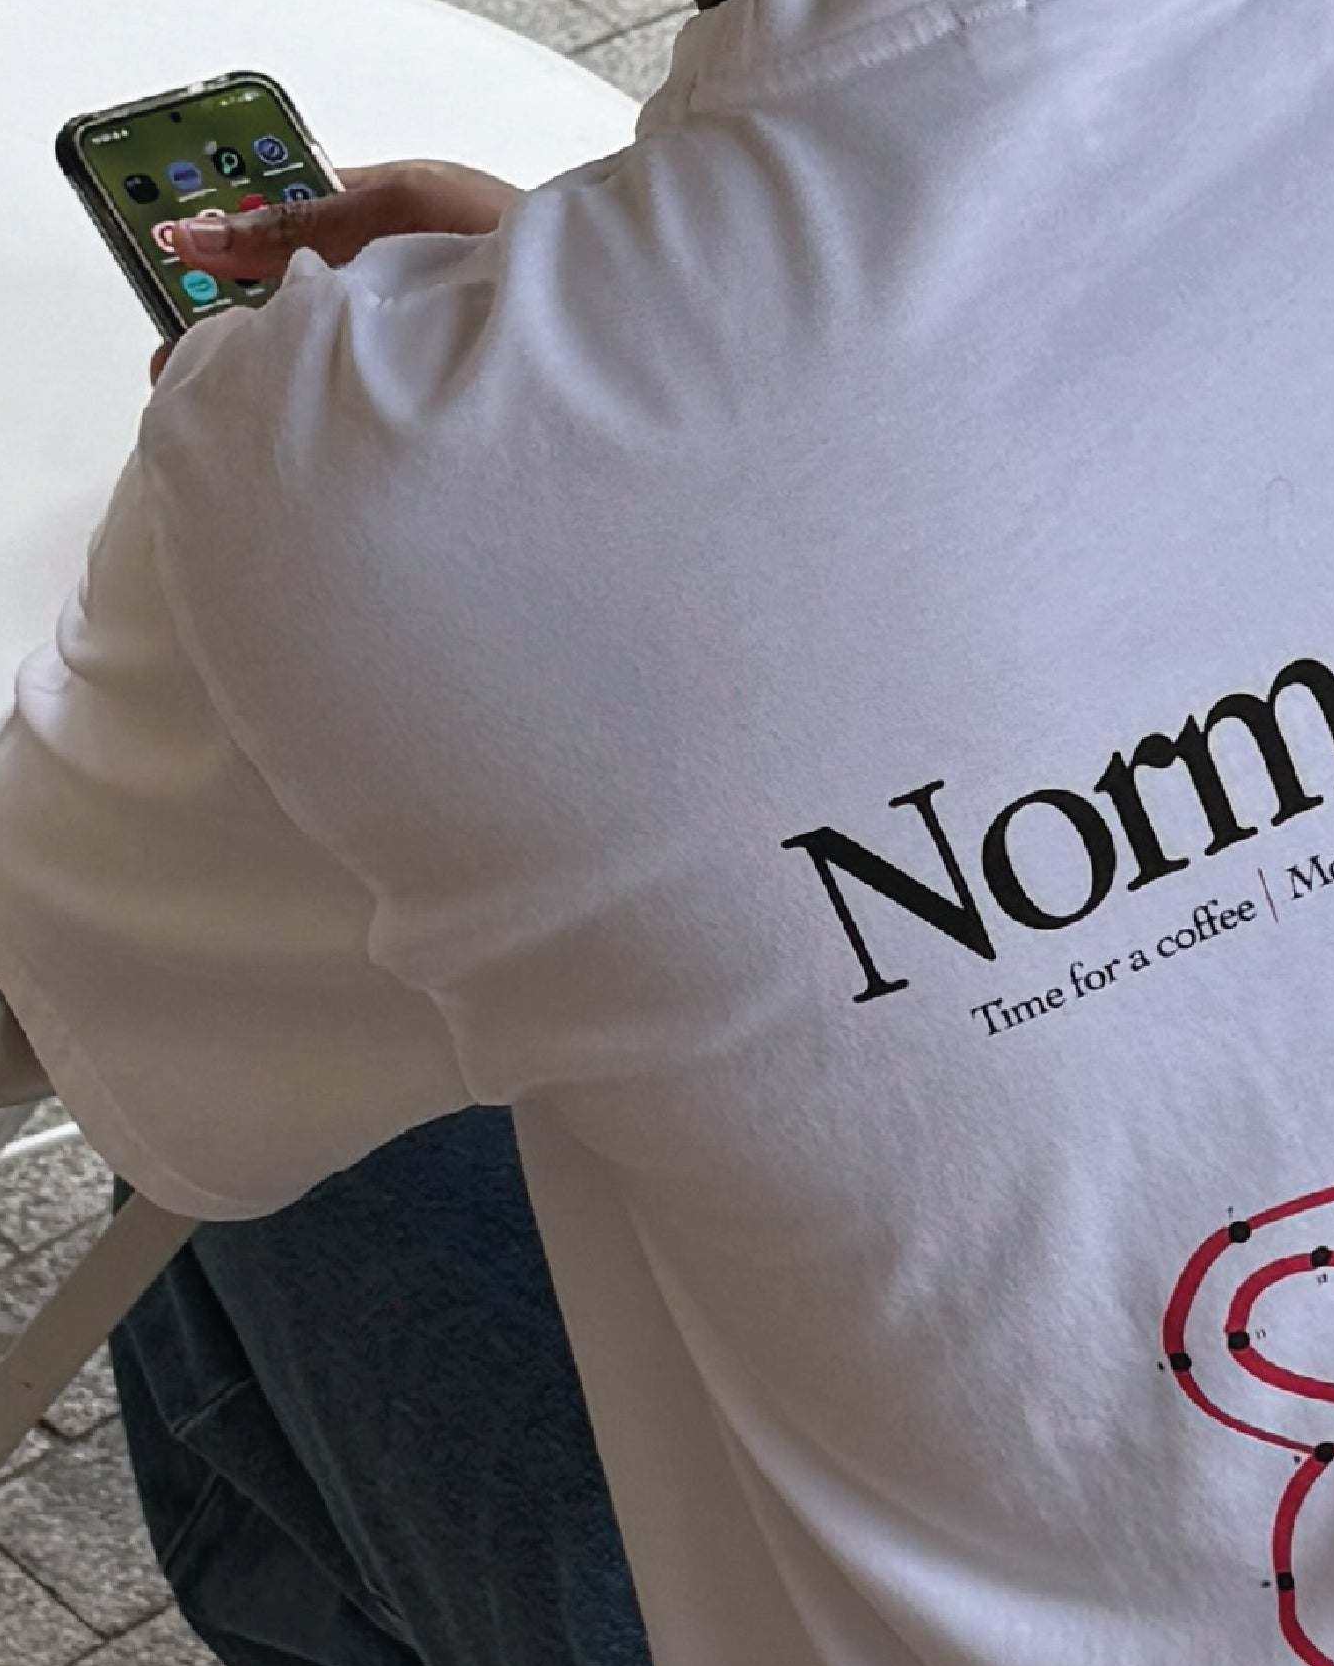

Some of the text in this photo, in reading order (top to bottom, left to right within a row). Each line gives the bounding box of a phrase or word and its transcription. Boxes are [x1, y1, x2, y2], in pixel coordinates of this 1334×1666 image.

[969, 987, 1065, 1036] Time
[1071, 960, 1121, 1000] for
[1128, 949, 1151, 973] a
[1157, 897, 1258, 959] coffee
